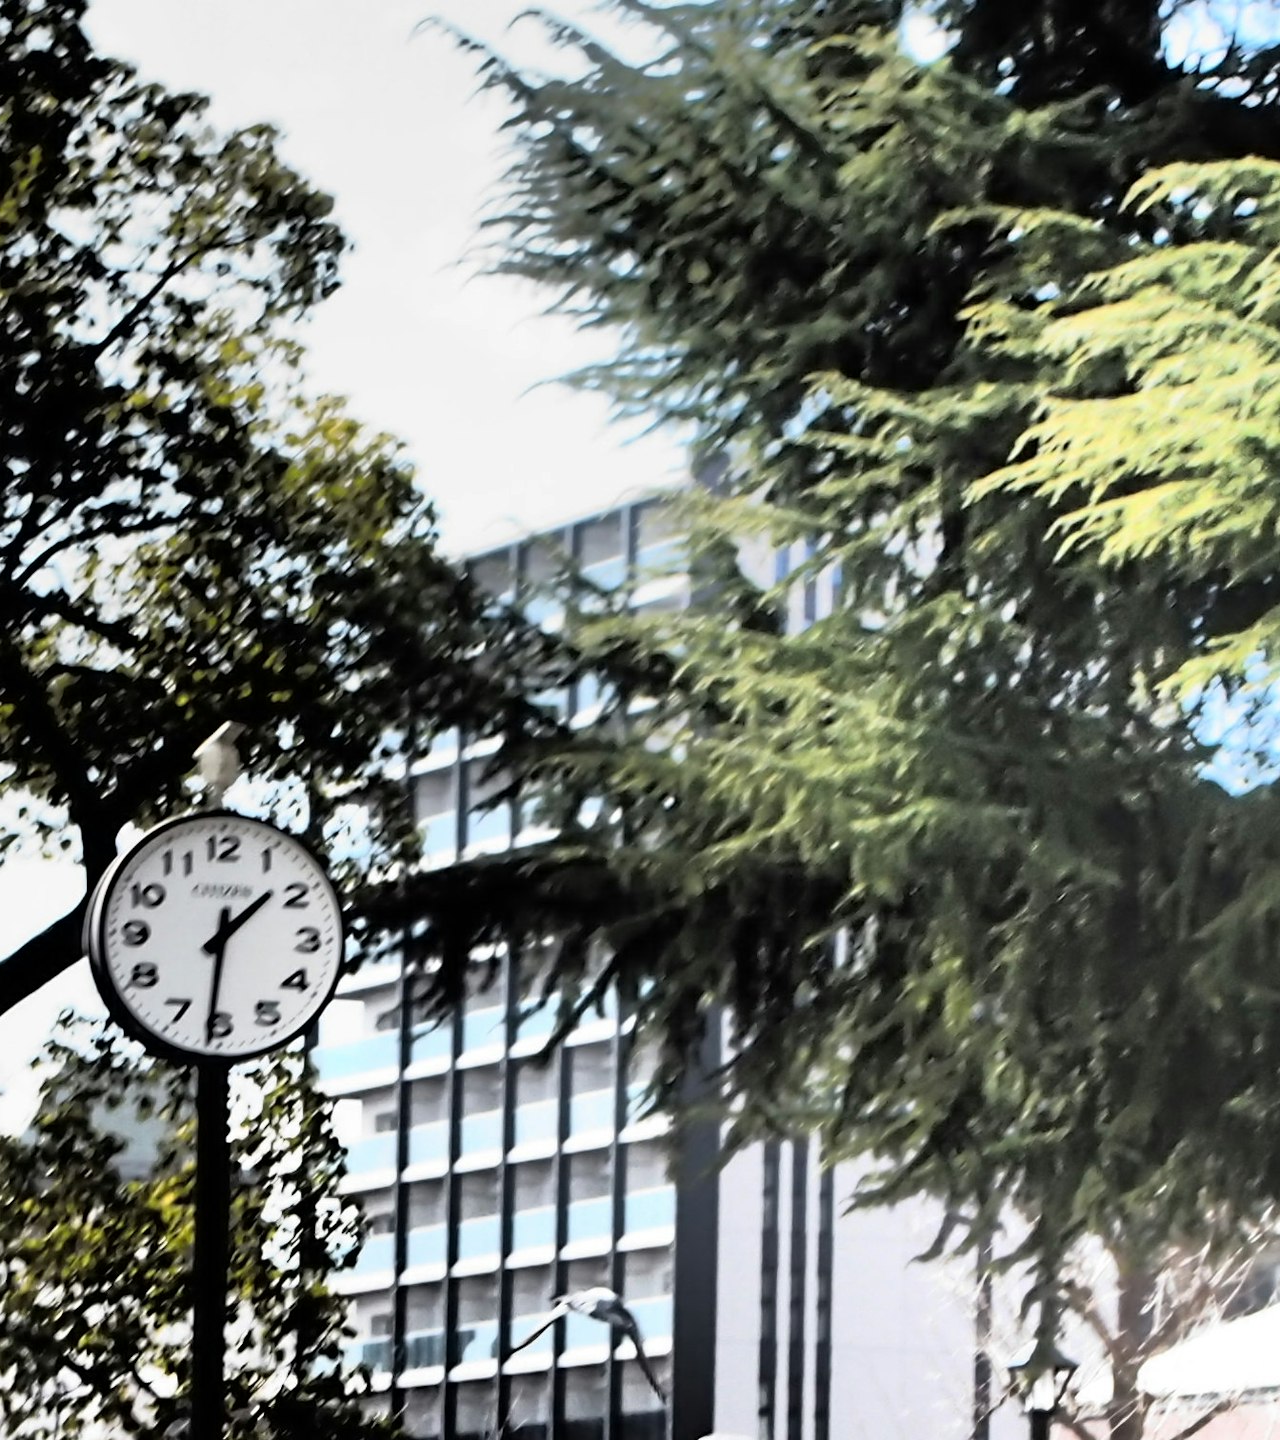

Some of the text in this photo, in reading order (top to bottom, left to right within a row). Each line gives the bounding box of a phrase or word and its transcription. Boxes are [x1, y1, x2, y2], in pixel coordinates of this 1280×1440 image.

[206, 835, 240, 863] 12
[261, 848, 272, 874] 1
[162, 849, 193, 877] 11
[130, 882, 166, 908] 10
[283, 883, 309, 909] 2
[121, 919, 151, 947] 9
[294, 926, 321, 952] 3
[131, 962, 159, 988] 8
[280, 968, 310, 992] 4
[164, 998, 192, 1024] 7
[254, 999, 281, 1026] 5
